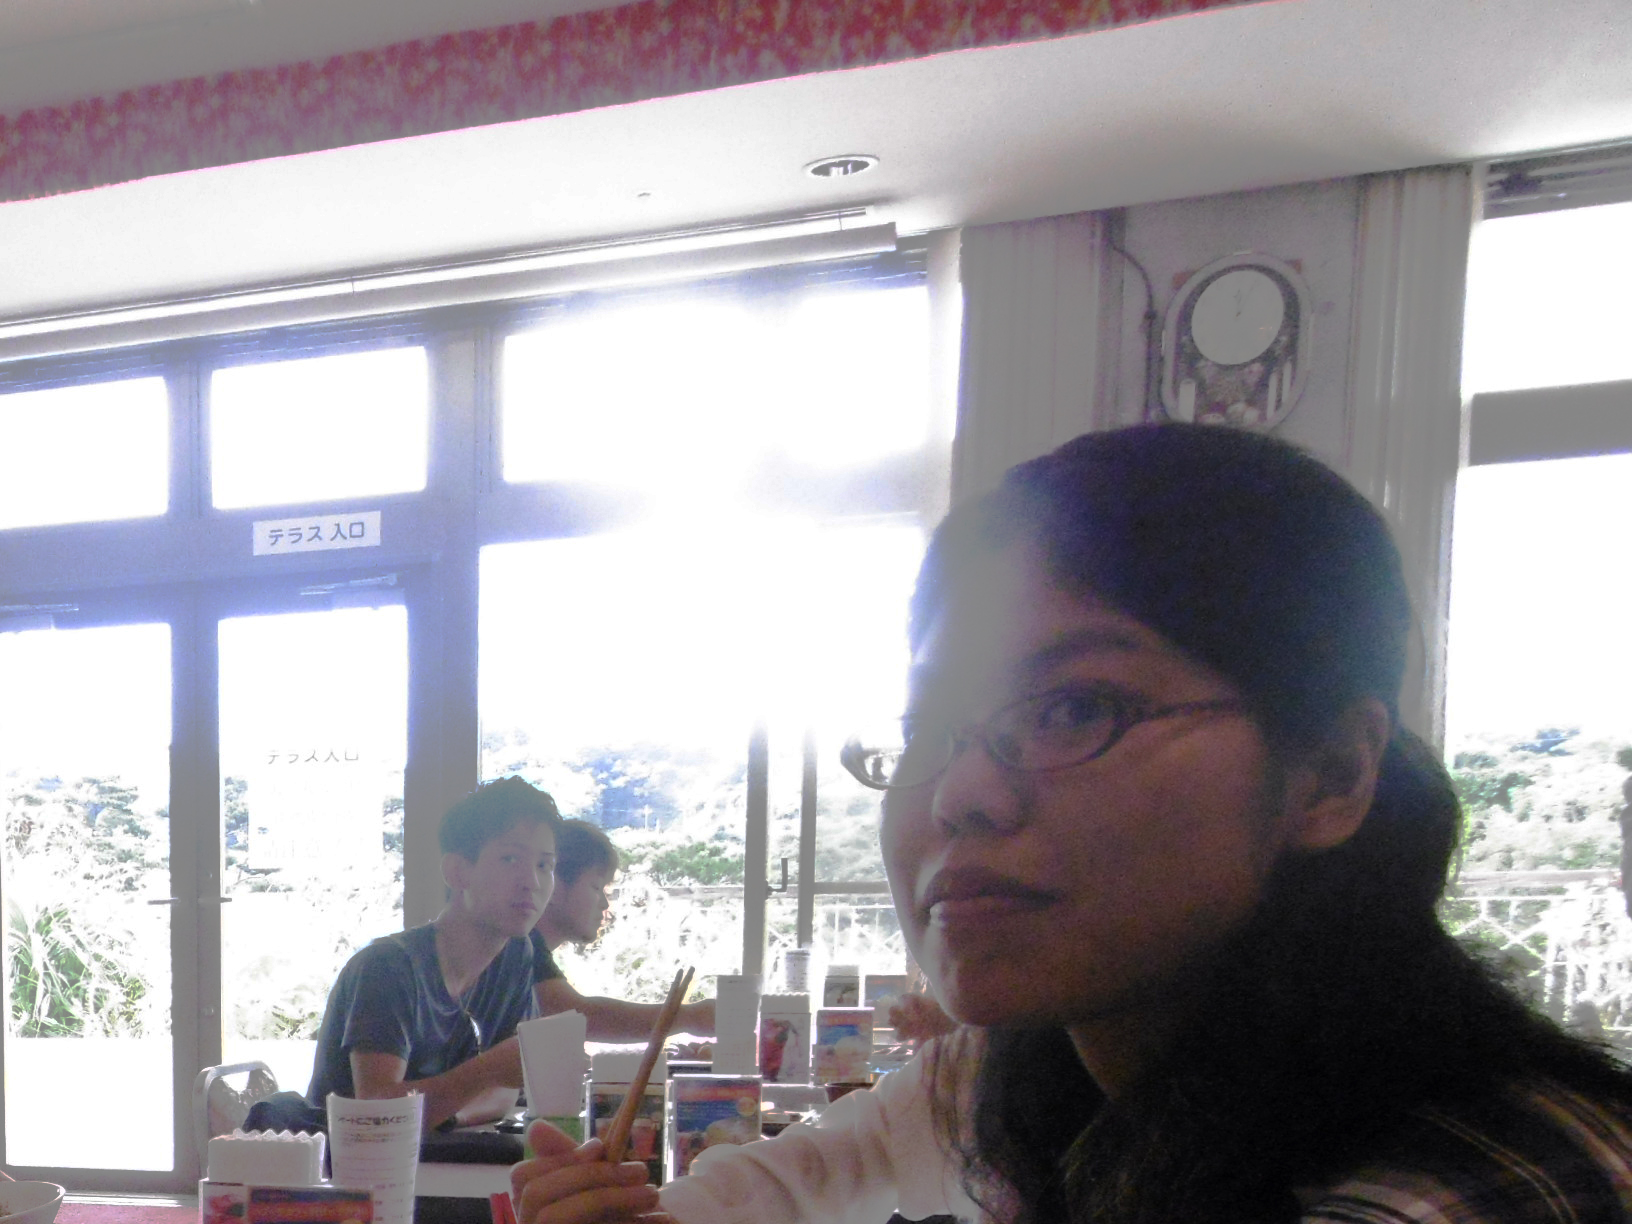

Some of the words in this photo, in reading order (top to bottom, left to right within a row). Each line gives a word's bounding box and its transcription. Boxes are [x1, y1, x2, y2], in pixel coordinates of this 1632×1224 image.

[269, 521, 365, 546] テラス入口
